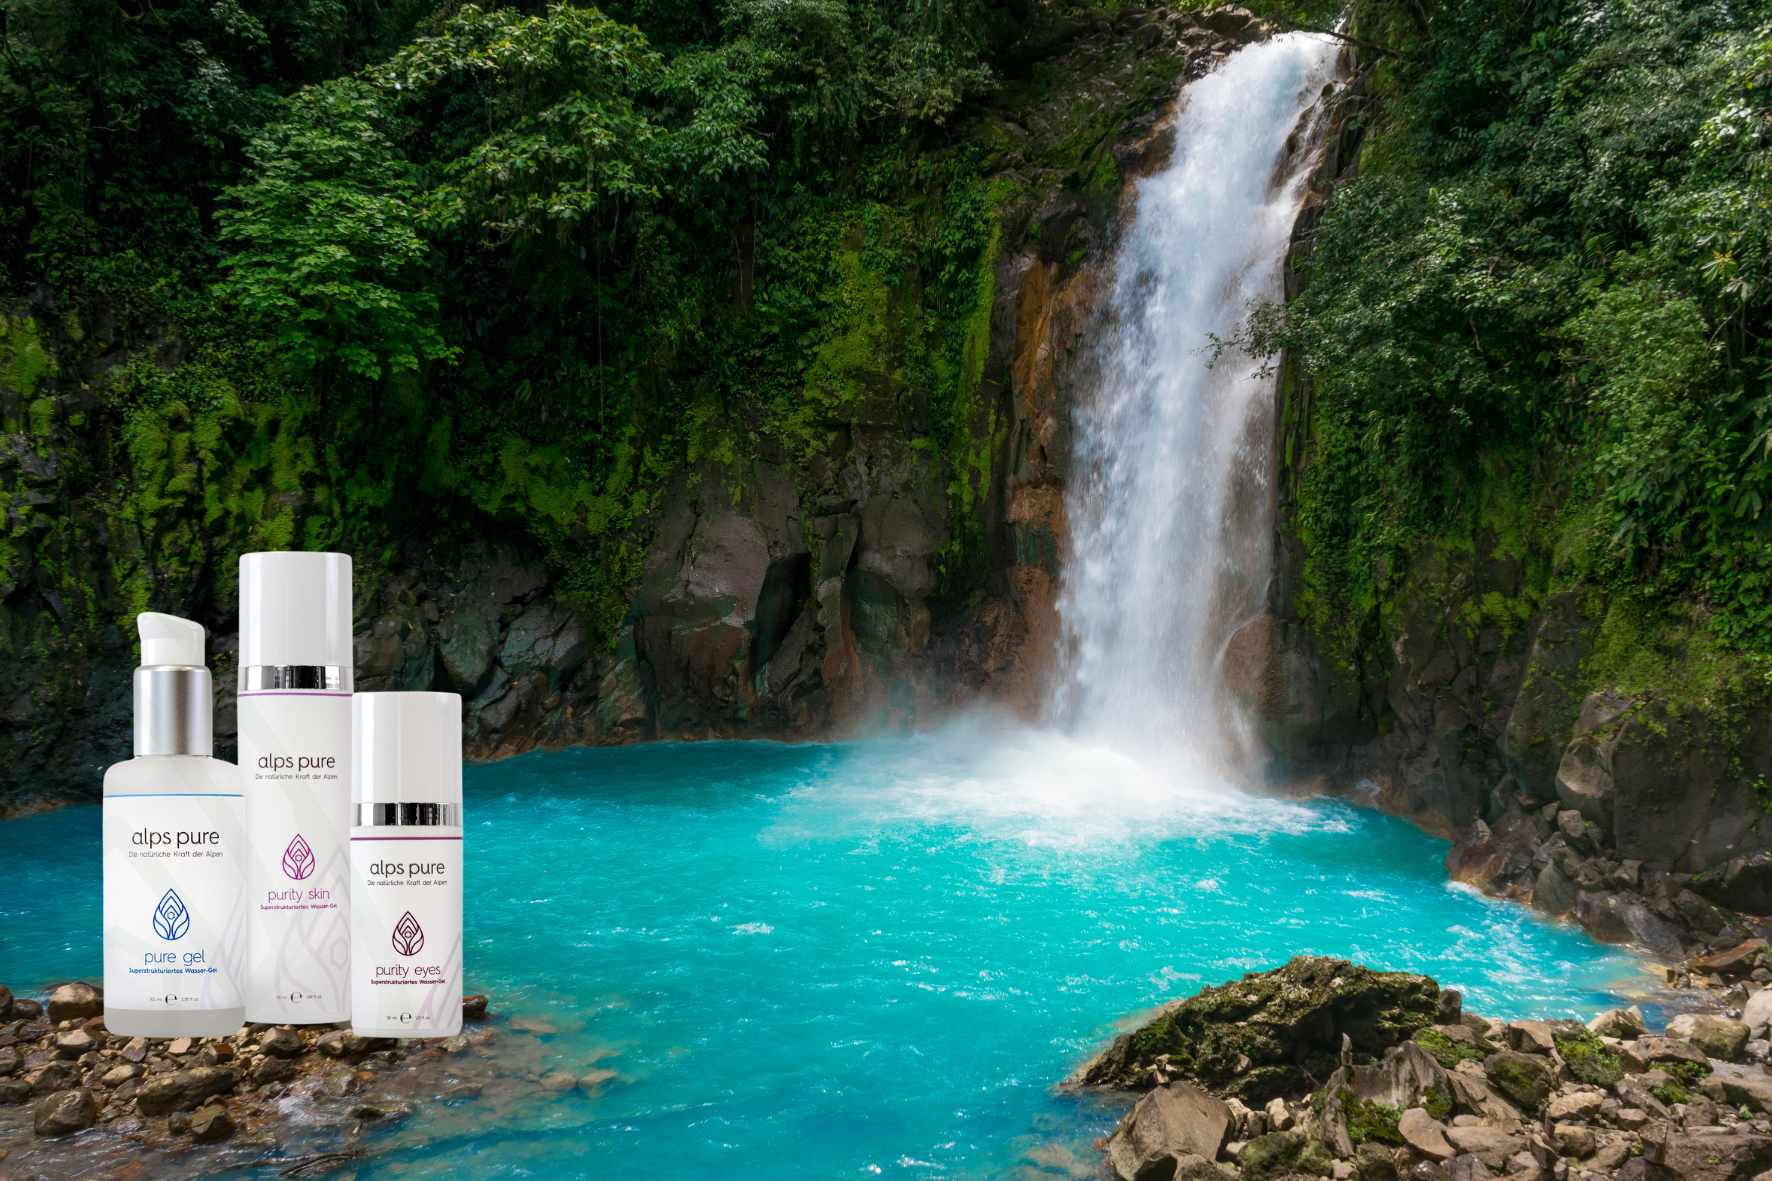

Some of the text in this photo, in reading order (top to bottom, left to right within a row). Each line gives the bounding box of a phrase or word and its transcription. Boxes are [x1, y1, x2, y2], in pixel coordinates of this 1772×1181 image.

[258, 753, 336, 772] alps pure
[131, 827, 220, 849] alps pure
[139, 850, 171, 858] natürliche
[173, 850, 190, 858] Kraft
[192, 850, 203, 858] der
[205, 850, 224, 858] Alpen
[369, 859, 445, 878] alps pure
[267, 887, 330, 904] purity skin
[144, 947, 206, 967] pure gel
[375, 963, 441, 978] purity eyes
